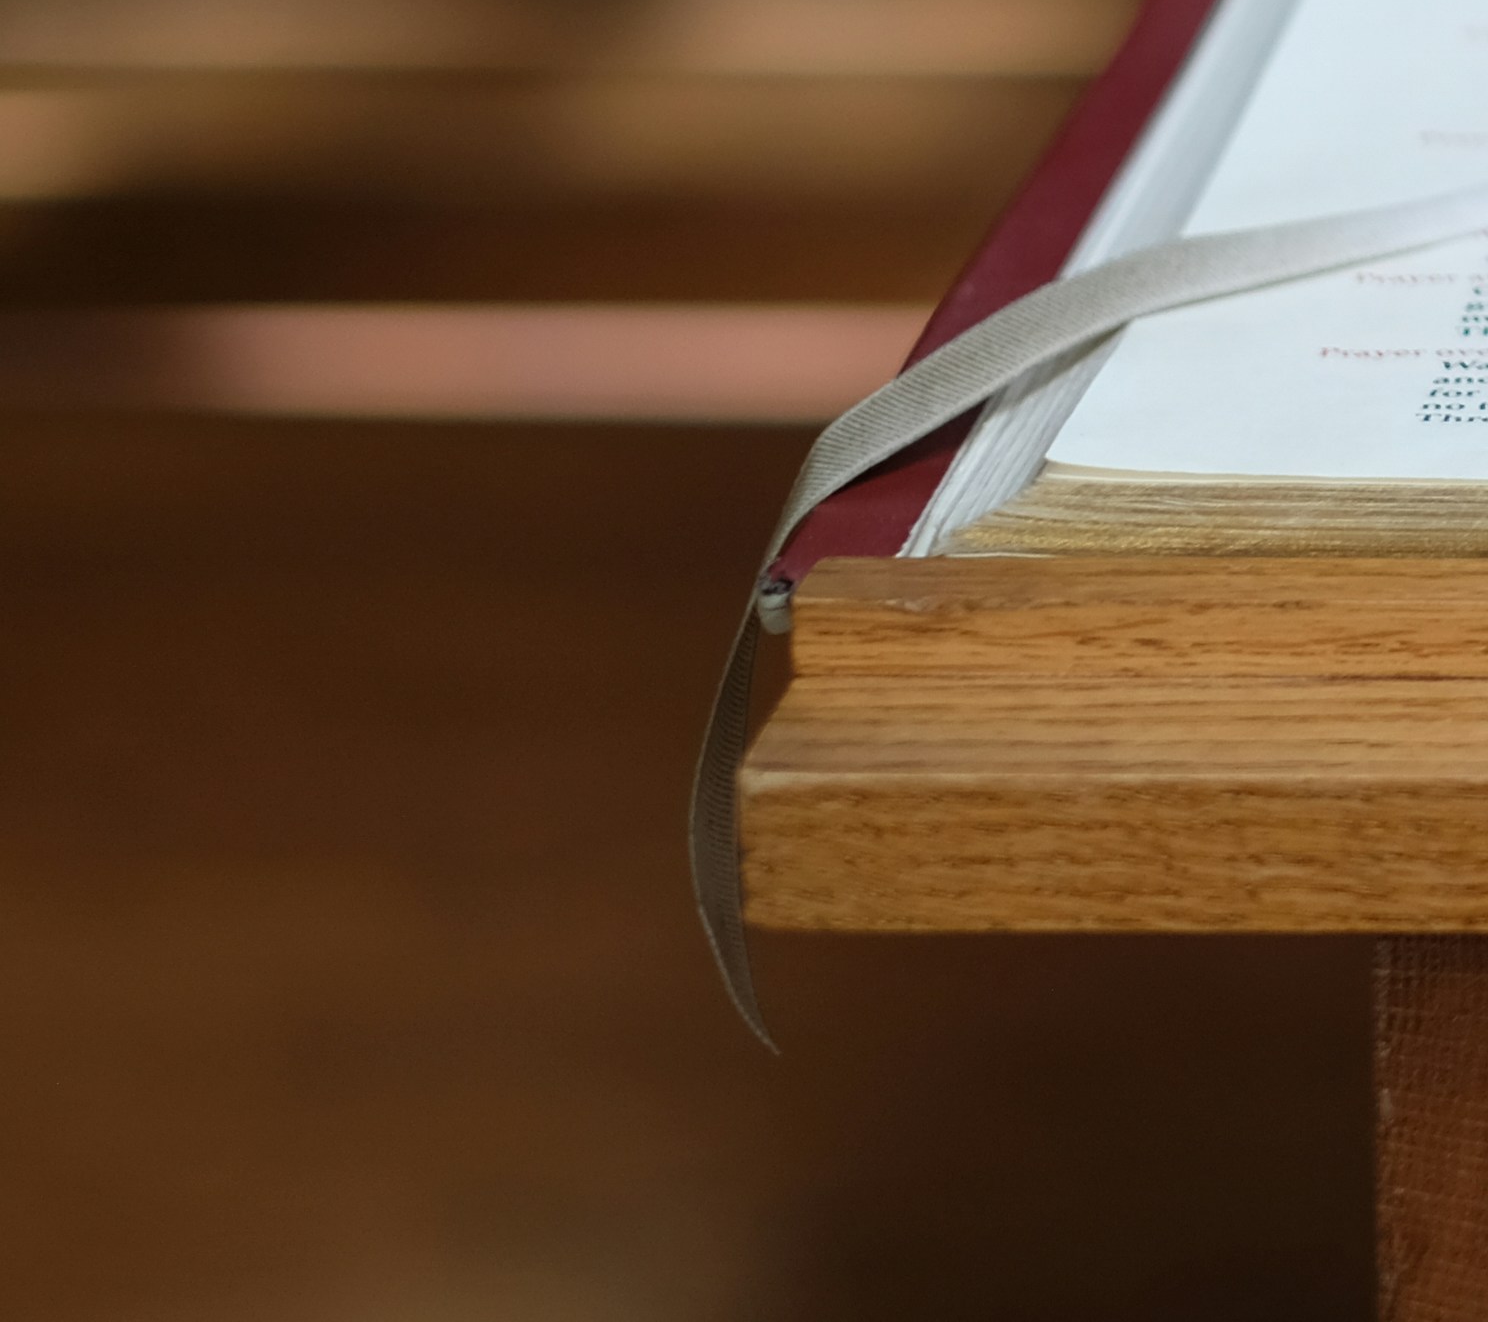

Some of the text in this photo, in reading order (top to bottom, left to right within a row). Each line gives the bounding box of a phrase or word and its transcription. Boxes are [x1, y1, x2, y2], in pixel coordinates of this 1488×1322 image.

[1319, 346, 1423, 362] Prayer
[1429, 386, 1481, 398] for
[1421, 402, 1466, 411] no
